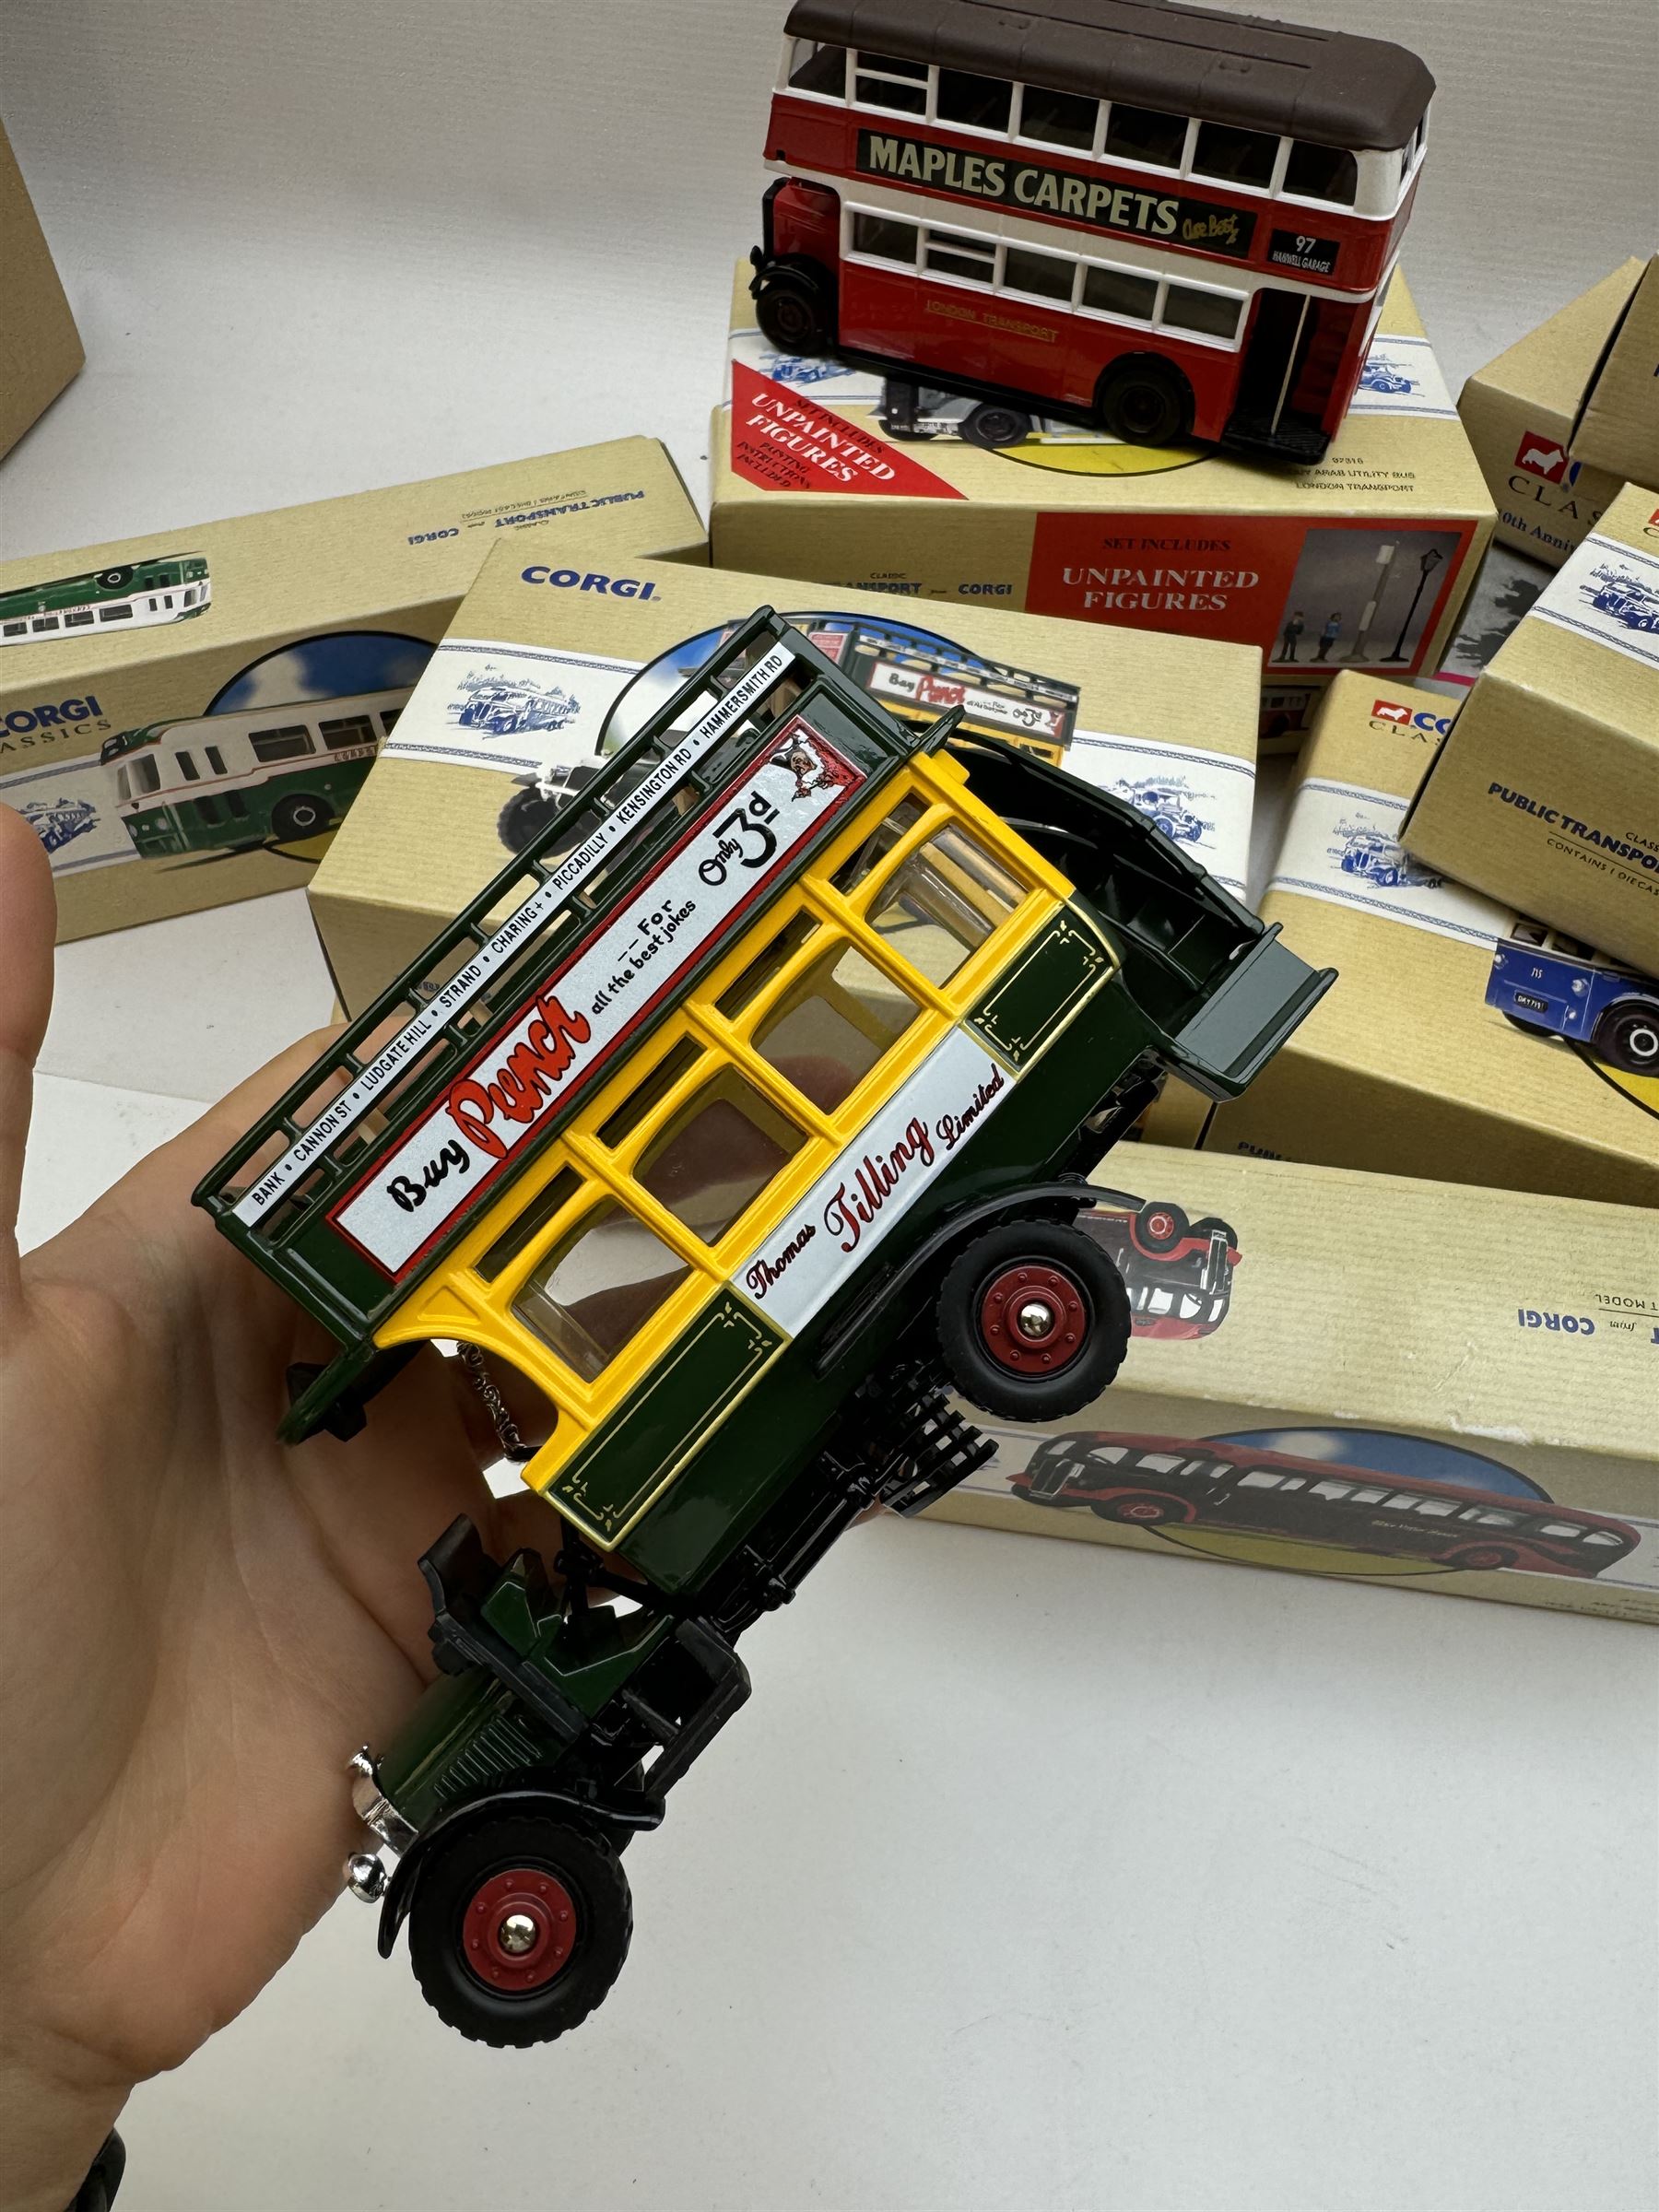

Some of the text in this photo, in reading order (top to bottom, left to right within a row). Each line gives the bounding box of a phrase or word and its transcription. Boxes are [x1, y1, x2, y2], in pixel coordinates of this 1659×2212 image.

[869, 135, 1006, 197] MAPLES
[1014, 169, 1180, 236] CARPETS
[1295, 235, 1316, 254] 97
[1301, 257, 1332, 274] GARAGE
[926, 300, 1059, 343] LONDON TRANSPORT
[746, 414, 859, 482] FIGURES
[751, 393, 896, 480] UNPAINTED
[495, 500, 591, 528] TRANSPORT
[590, 490, 645, 508] PUBLIC
[408, 528, 460, 545] CORGI
[1103, 538, 1231, 552] SET INCLUDES
[521, 565, 657, 601] CORGI
[959, 583, 1012, 595] CORGI
[1062, 567, 1260, 589] UNPAINTED
[1083, 591, 1229, 612] FIGURES
[0, 719, 112, 754] ASSICS
[1488, 782, 1659, 874] PUBLIC TRANSPO
[1625, 831, 1659, 853] CLASS
[698, 837, 745, 887] Only
[1547, 838, 1607, 871] CONTAINS
[1618, 872, 1659, 897] DIECAS
[252, 1171, 286, 1206] BANK
[293, 1113, 340, 1162] CANNON
[334, 1100, 353, 1119] ST
[360, 1041, 410, 1091] LUDGATE
[403, 1019, 432, 1045] HILL
[439, 965, 482, 1008] STRAND
[491, 907, 538, 954] CHARING
[553, 832, 608, 890] PICCADILLY
[616, 760, 680, 825] KENSINGTON
[674, 747, 692, 767] RD
[700, 670, 772, 740] HAMMERSMITH
[764, 654, 783, 678] RD
[637, 900, 673, 936] For
[591, 900, 697, 1016] all the best jokes
[386, 995, 592, 1213] Buy Punch
[746, 1063, 1005, 1300] Thomas Tilling Limited
[1594, 1293, 1646, 1309] MODEL
[1517, 1309, 1595, 1335] CORGI
